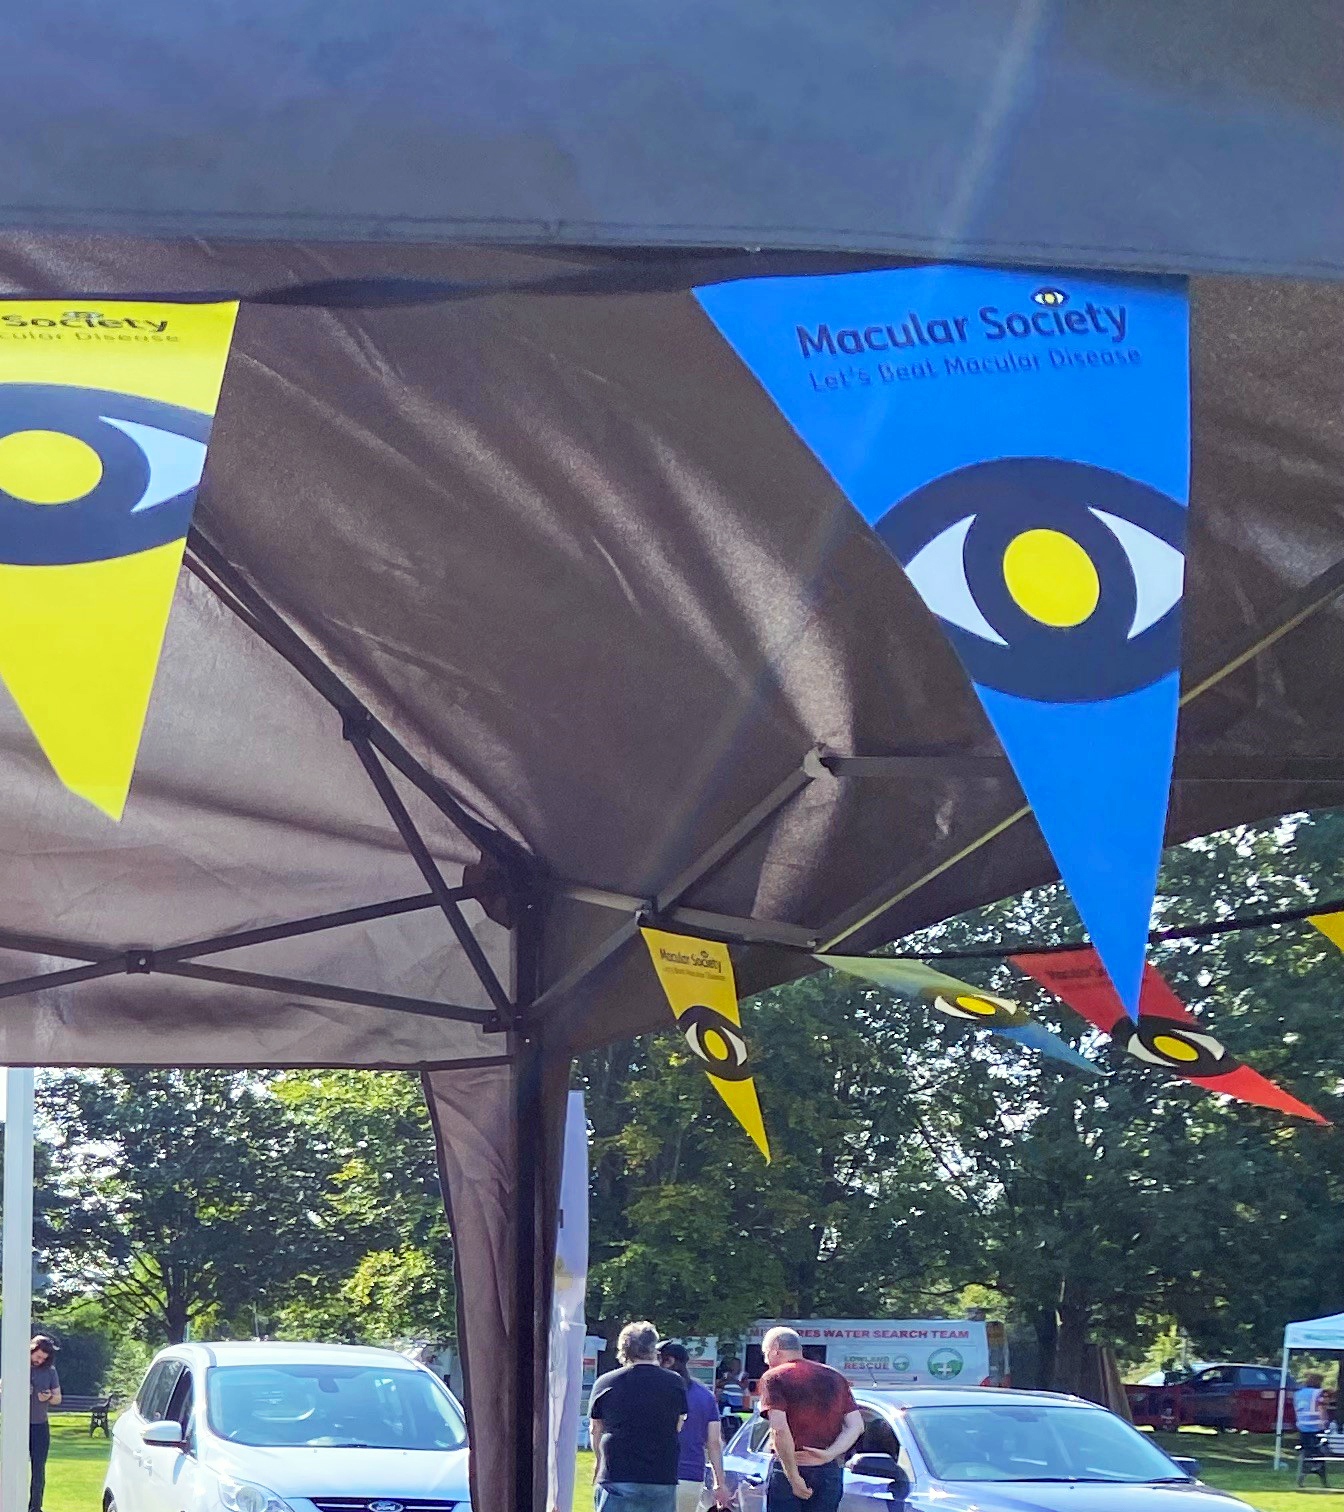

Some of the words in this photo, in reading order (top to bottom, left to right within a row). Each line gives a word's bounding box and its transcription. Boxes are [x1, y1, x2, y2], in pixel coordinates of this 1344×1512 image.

[1, 313, 169, 332] Society
[796, 308, 968, 359] Macular
[979, 301, 1128, 343] Society
[809, 366, 870, 392] Let's
[879, 360, 937, 384] Beat
[945, 351, 1042, 377] Macular
[1050, 346, 1141, 370] Disease
[824, 1328, 870, 1339] WATER
[873, 1328, 928, 1339] SEARCH
[932, 1329, 970, 1339] TEAM
[844, 1362, 890, 1370] RESCUE
